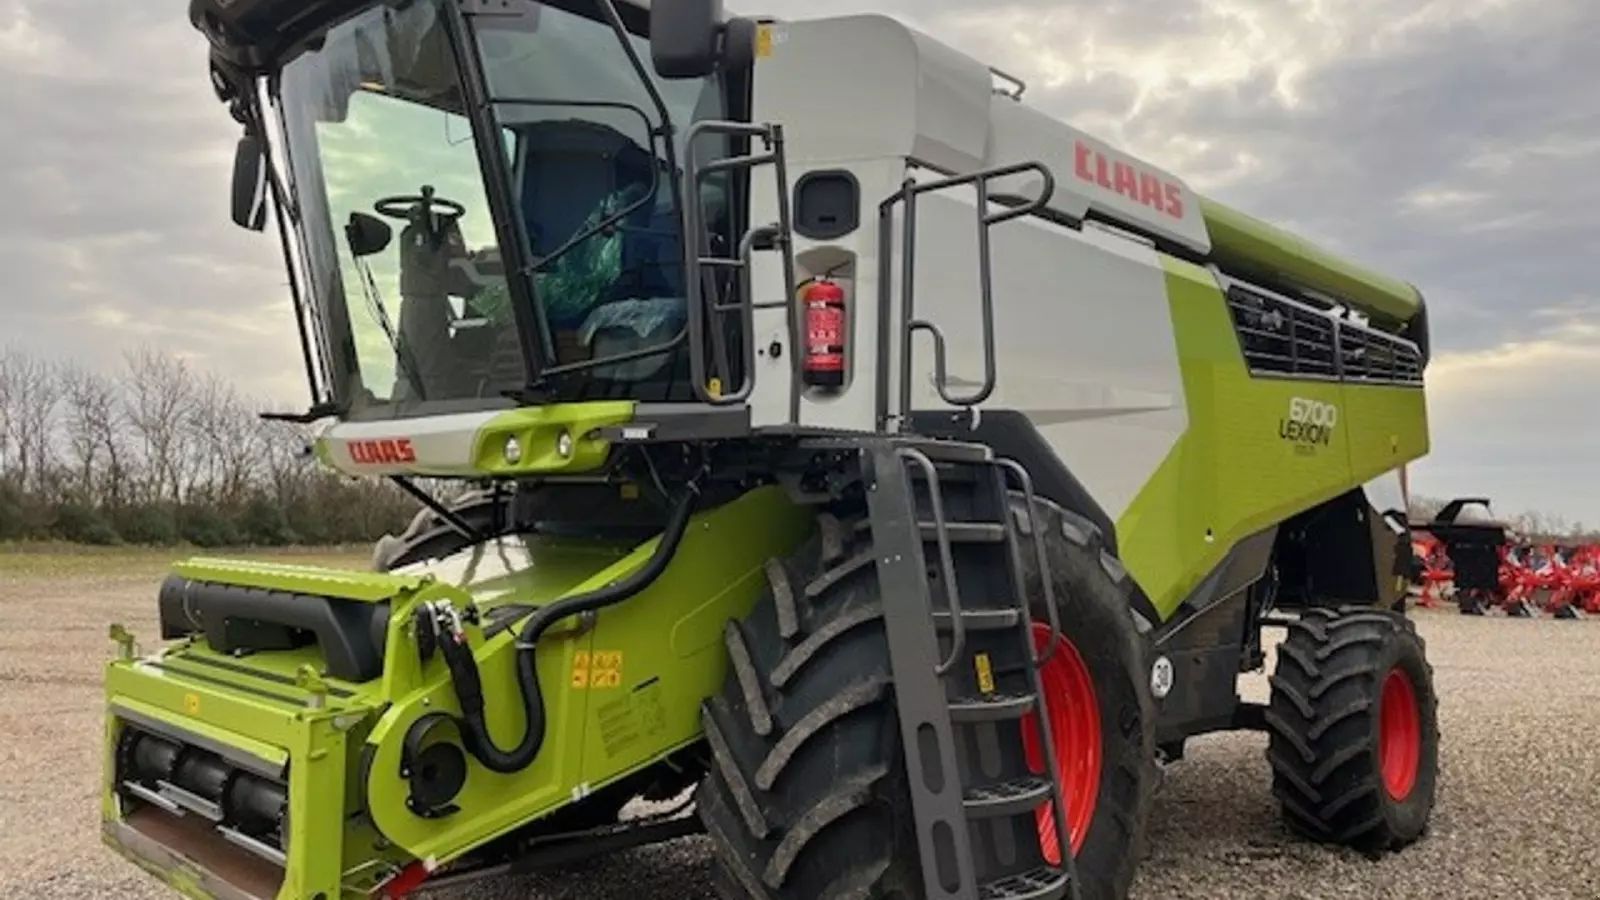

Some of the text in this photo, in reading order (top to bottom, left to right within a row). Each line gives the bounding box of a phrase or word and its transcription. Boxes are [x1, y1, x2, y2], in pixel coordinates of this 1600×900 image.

[1074, 140, 1184, 220] CLAAS
[1289, 396, 1337, 427] 6700
[1279, 417, 1330, 447] LEXION
[346, 439, 416, 464] CLAAS
[1156, 664, 1169, 689] 30
